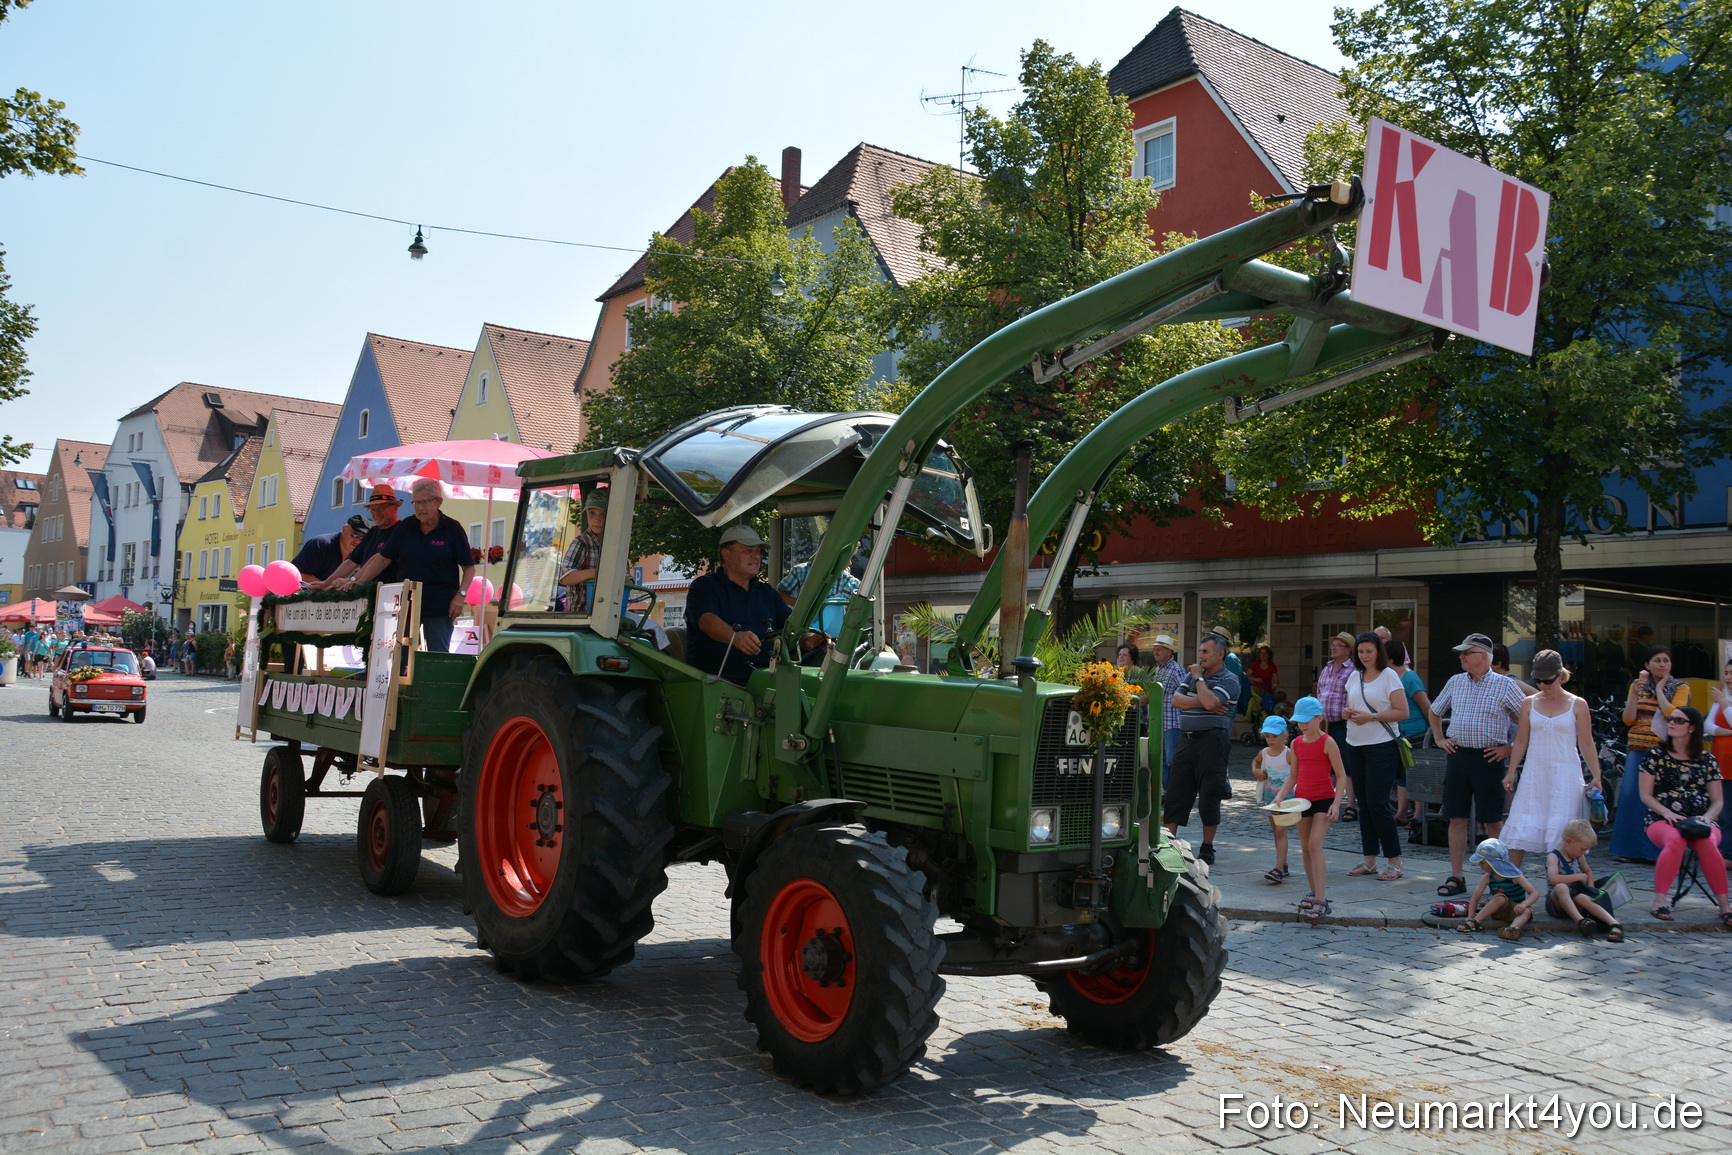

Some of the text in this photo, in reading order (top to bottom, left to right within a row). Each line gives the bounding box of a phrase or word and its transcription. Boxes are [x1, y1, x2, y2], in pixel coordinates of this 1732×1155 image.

[1368, 126, 1540, 332] KAB
[1458, 490, 1684, 543] ANON
[204, 532, 219, 545] HOTEL
[1135, 528, 1206, 557] JOSEF
[1058, 758, 1117, 774] FENT
